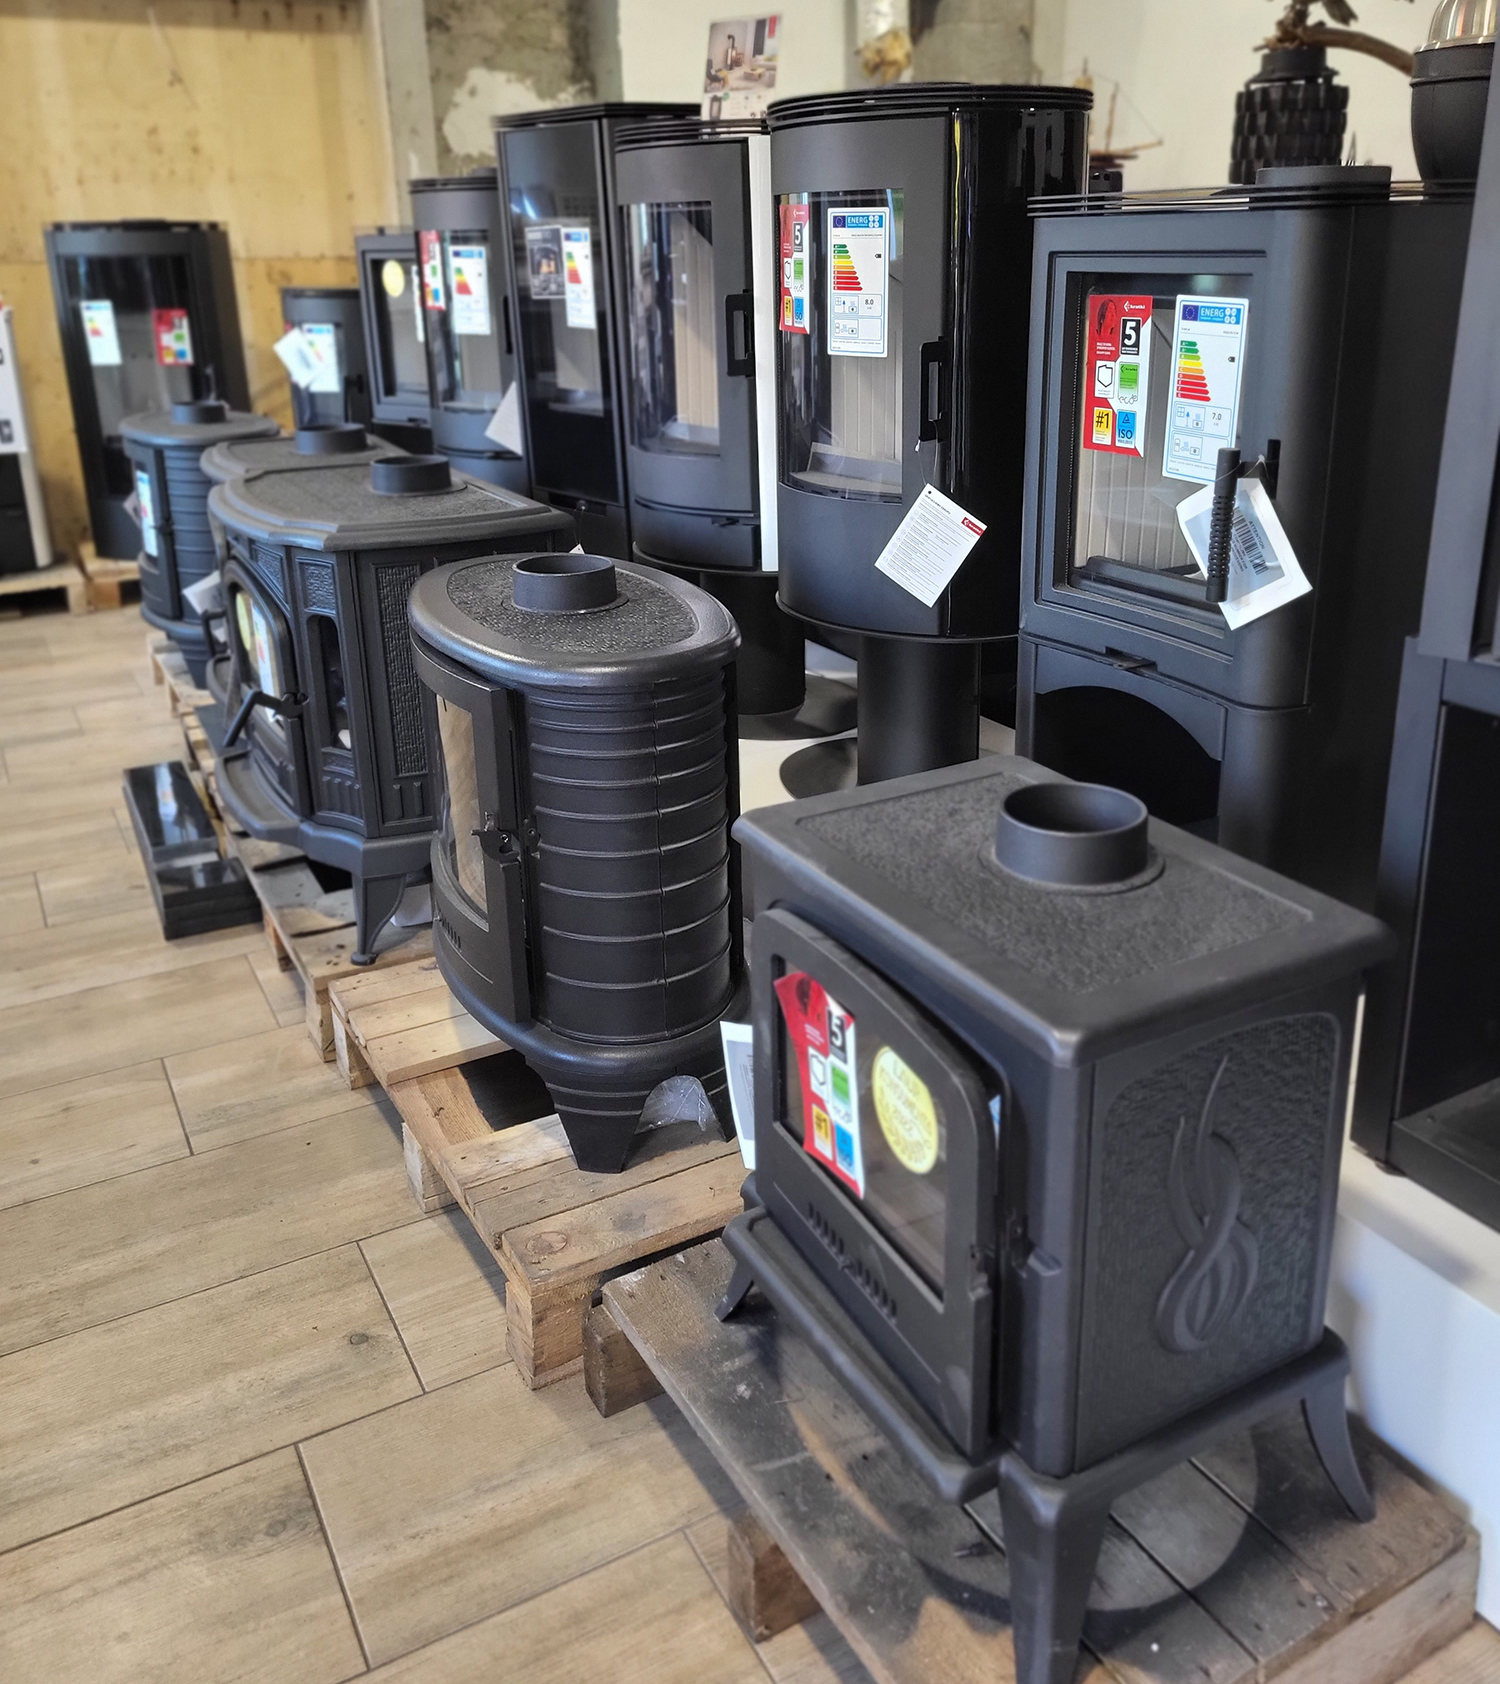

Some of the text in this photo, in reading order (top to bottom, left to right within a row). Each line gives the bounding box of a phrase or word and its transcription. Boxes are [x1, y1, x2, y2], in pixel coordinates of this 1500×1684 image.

[847, 216, 868, 224] ENERG
[795, 225, 801, 245] 5
[864, 298, 874, 306] 8.0
[1200, 307, 1225, 318] ENERG
[1123, 321, 1136, 346] 5
[1095, 411, 1110, 429] #1
[1212, 412, 1222, 421] 7.0
[1118, 428, 1134, 440] ISO
[1249, 521, 1265, 549] ATTENTION
[830, 1015, 844, 1047] 5
